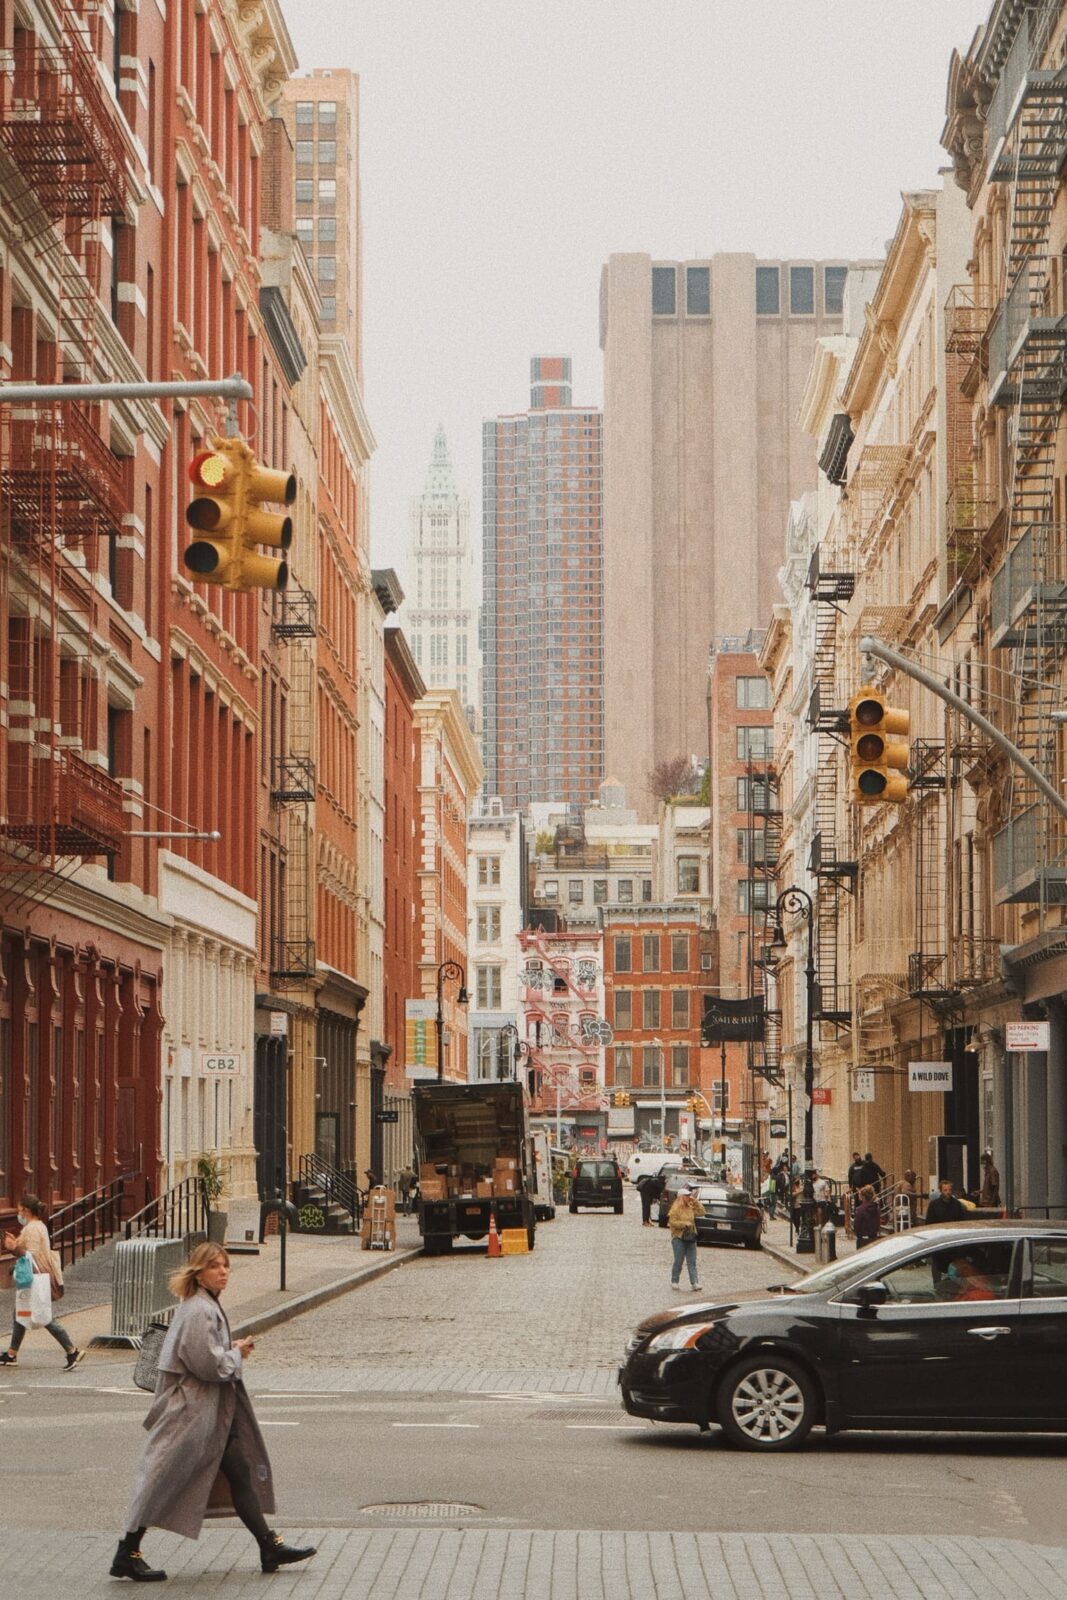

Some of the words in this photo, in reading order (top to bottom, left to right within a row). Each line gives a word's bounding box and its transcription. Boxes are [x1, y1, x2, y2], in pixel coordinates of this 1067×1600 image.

[206, 1058, 235, 1070] CB2
[912, 1072, 917, 1081] A
[917, 1072, 933, 1081] WILD
[933, 1072, 949, 1081] DOVE
